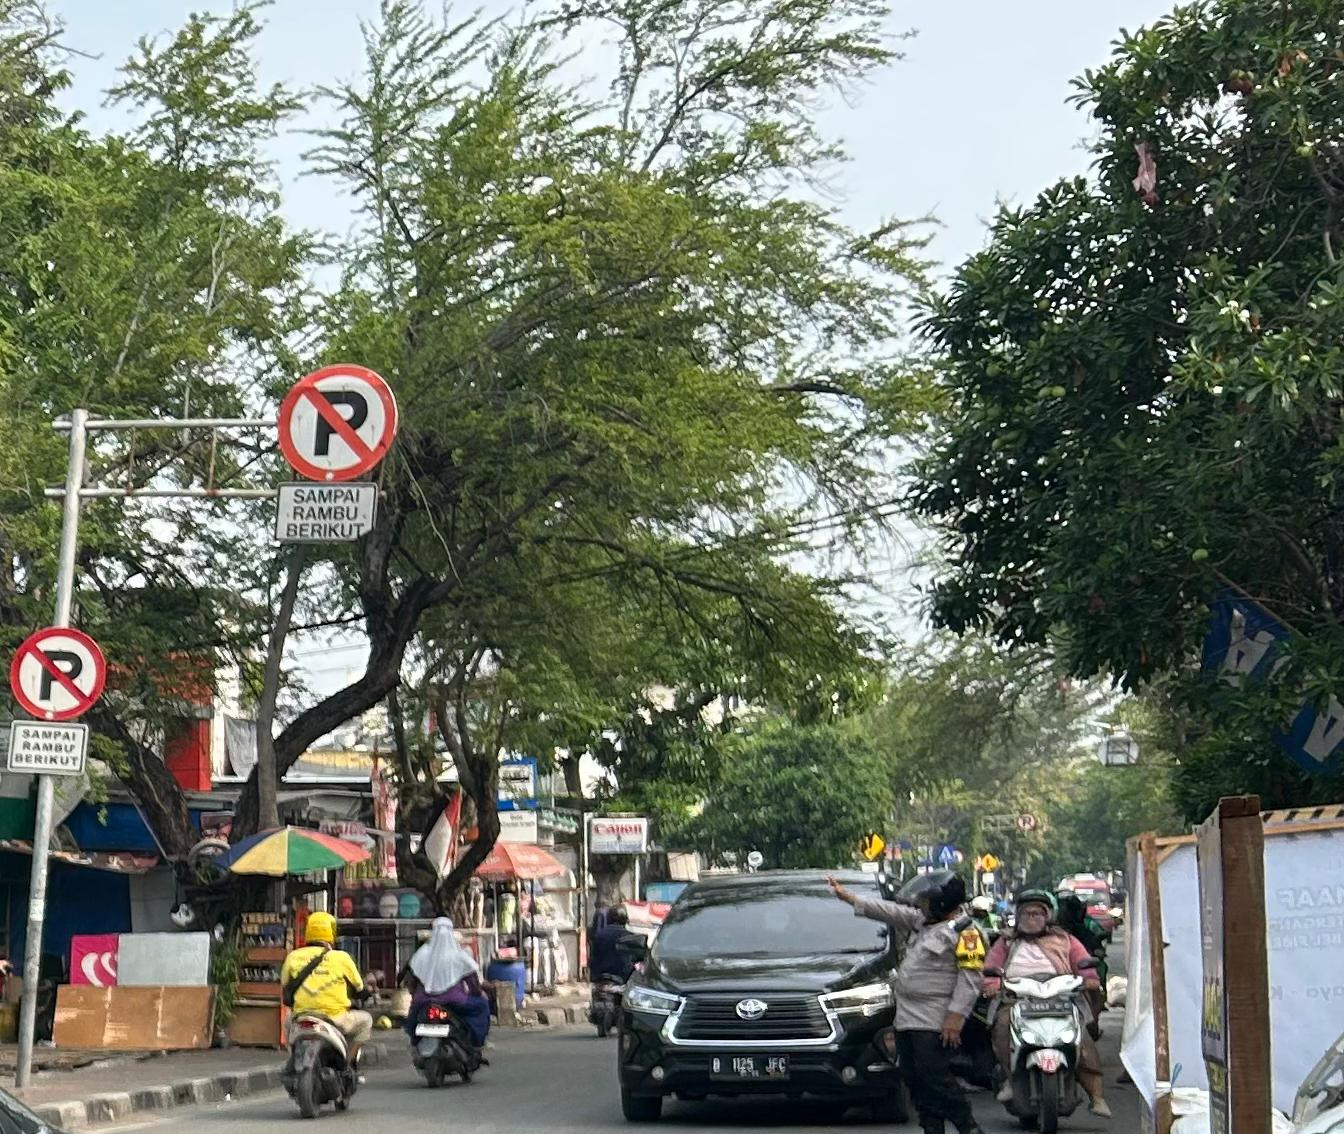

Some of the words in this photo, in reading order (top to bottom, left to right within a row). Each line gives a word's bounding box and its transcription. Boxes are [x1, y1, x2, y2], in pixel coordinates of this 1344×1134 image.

[314, 391, 368, 456] P
[293, 488, 360, 504] SAMPAI
[293, 505, 358, 521] RAMBU
[286, 522, 365, 538] BERIKUT
[39, 650, 83, 701] P
[22, 728, 76, 741] SAMPAI
[22, 740, 75, 753] RAMBU
[15, 753, 79, 767] BERIKUT
[594, 821, 642, 836] Canon
